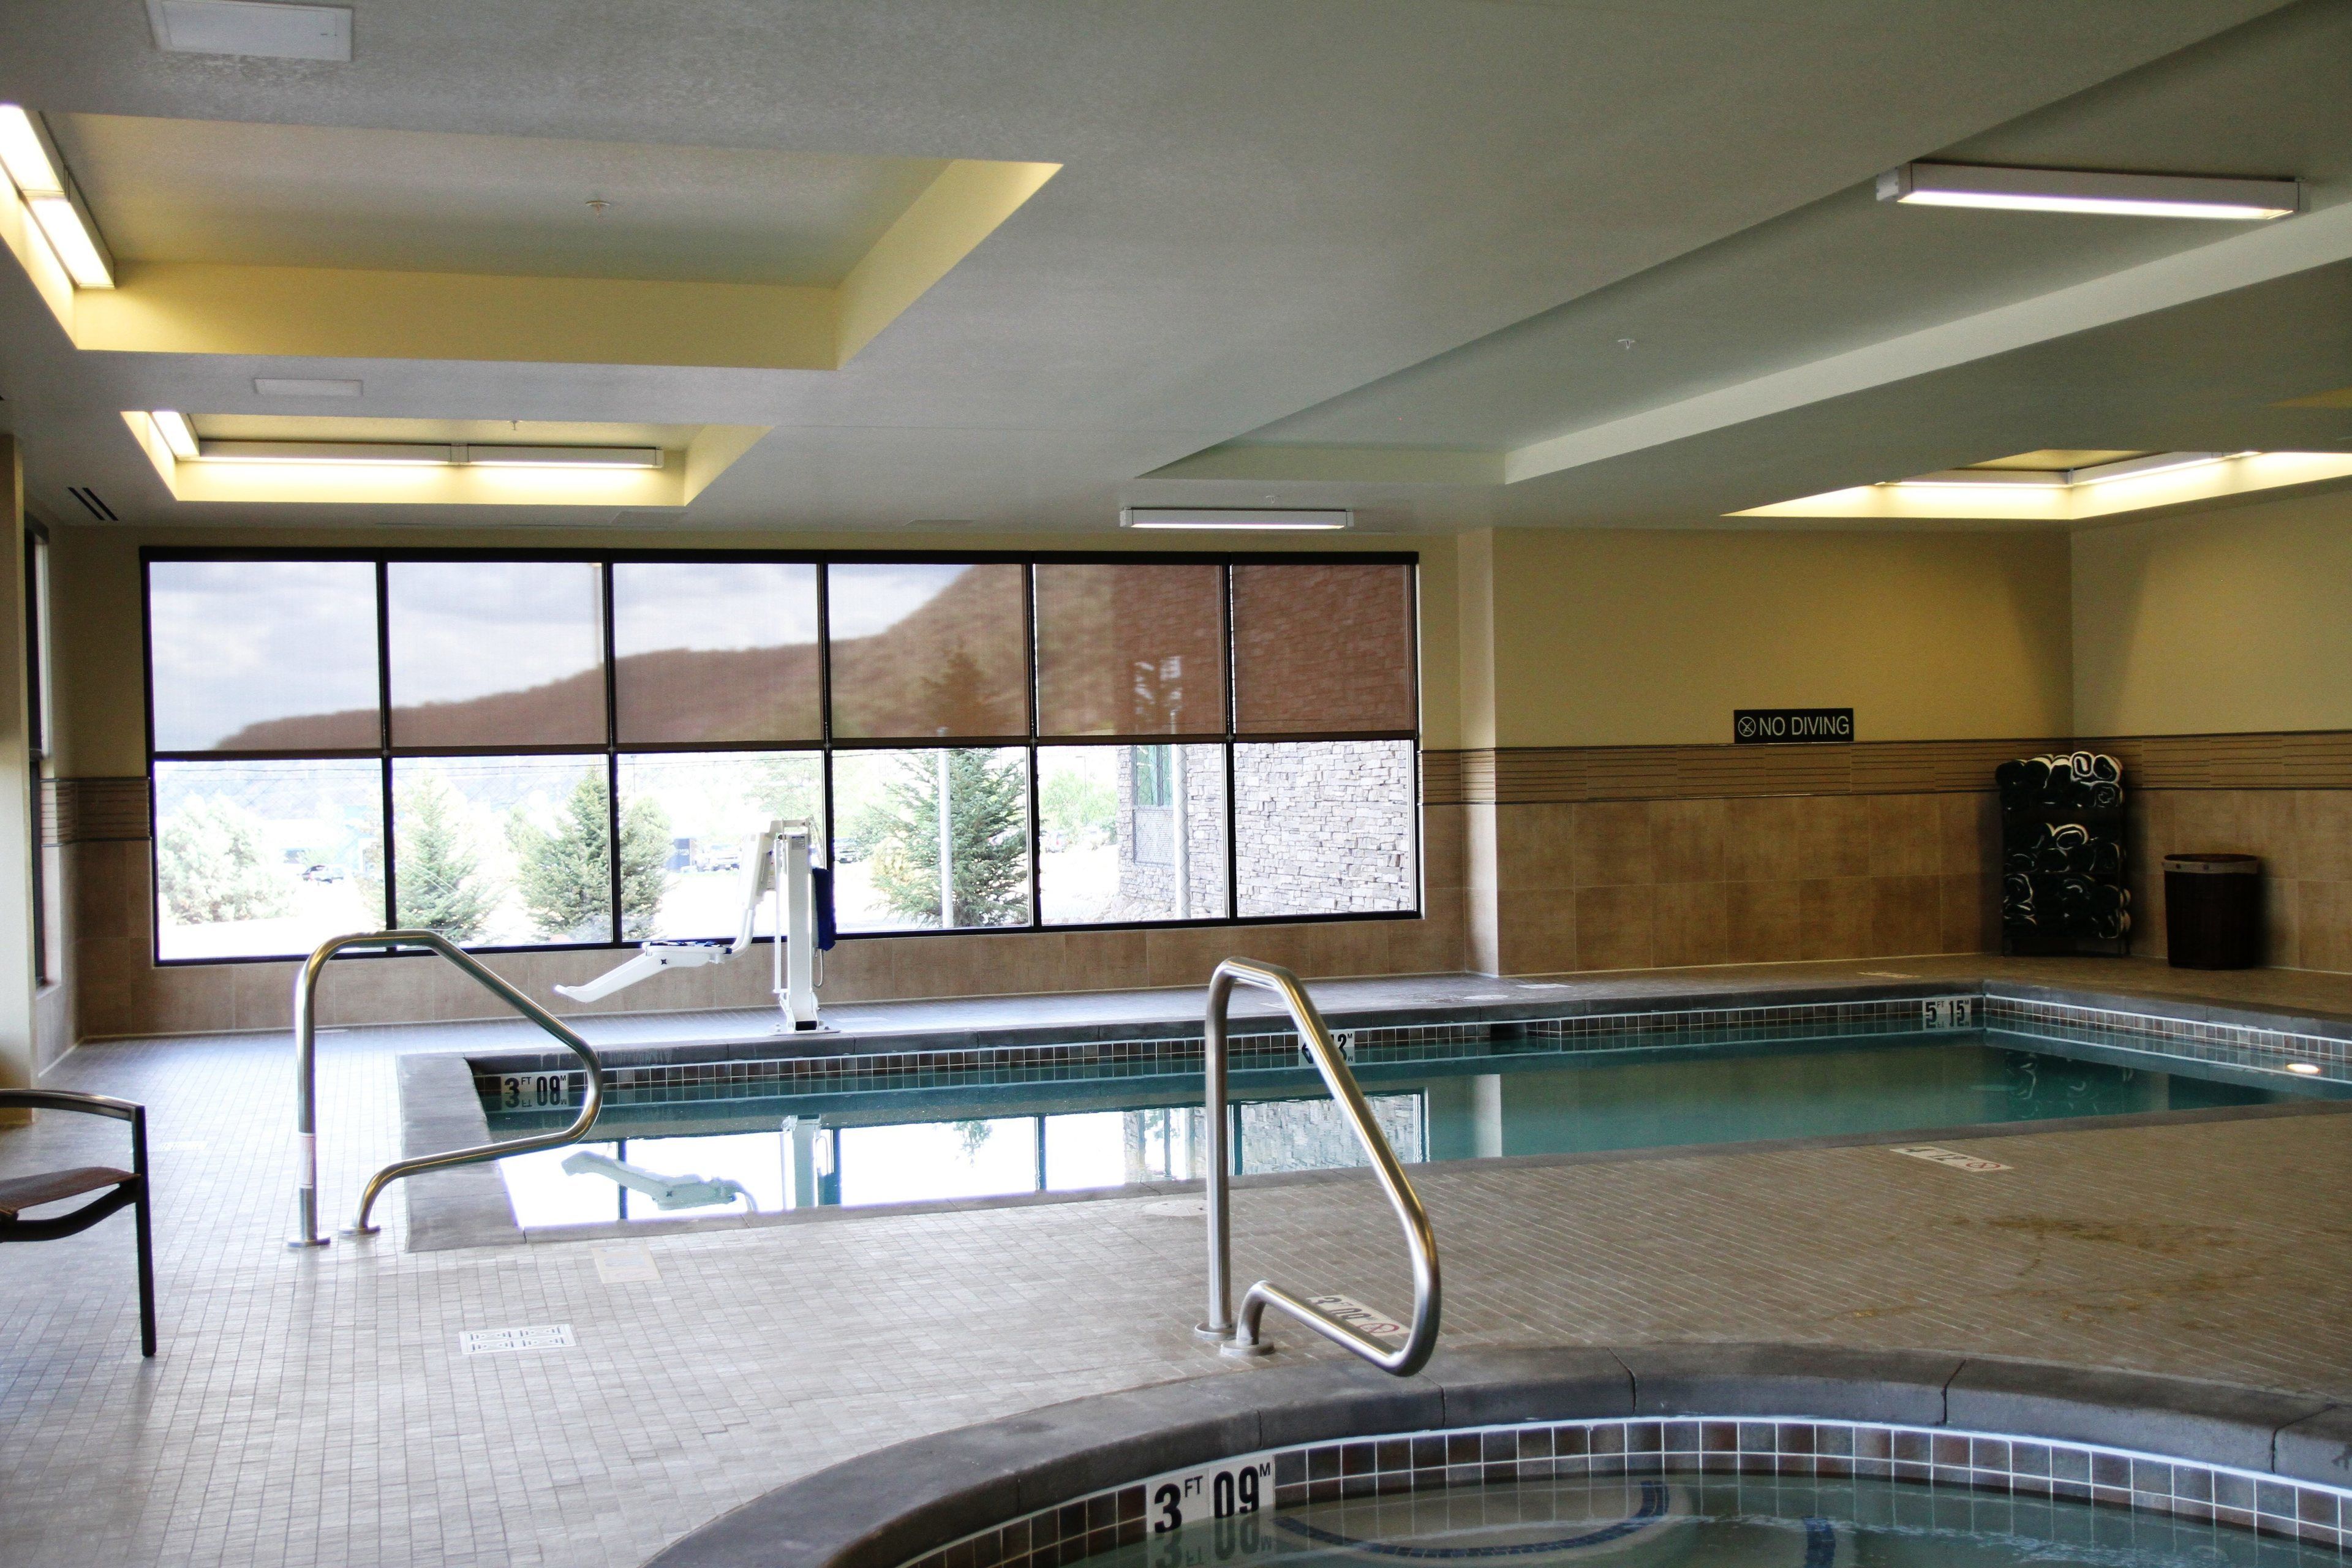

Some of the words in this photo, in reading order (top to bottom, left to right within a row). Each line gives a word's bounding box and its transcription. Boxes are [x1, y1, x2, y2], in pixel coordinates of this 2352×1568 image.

[1760, 717, 1785, 736] NO
[1792, 716, 1849, 735] DIVING
[1926, 1001, 1937, 1016] 5
[1950, 1000, 1965, 1014] 15
[505, 1077, 519, 1093] 3
[1155, 1483, 1182, 1533] 3
[1185, 1476, 1203, 1498] FT
[1214, 1466, 1259, 1519] 09
[1259, 1462, 1270, 1477] M
